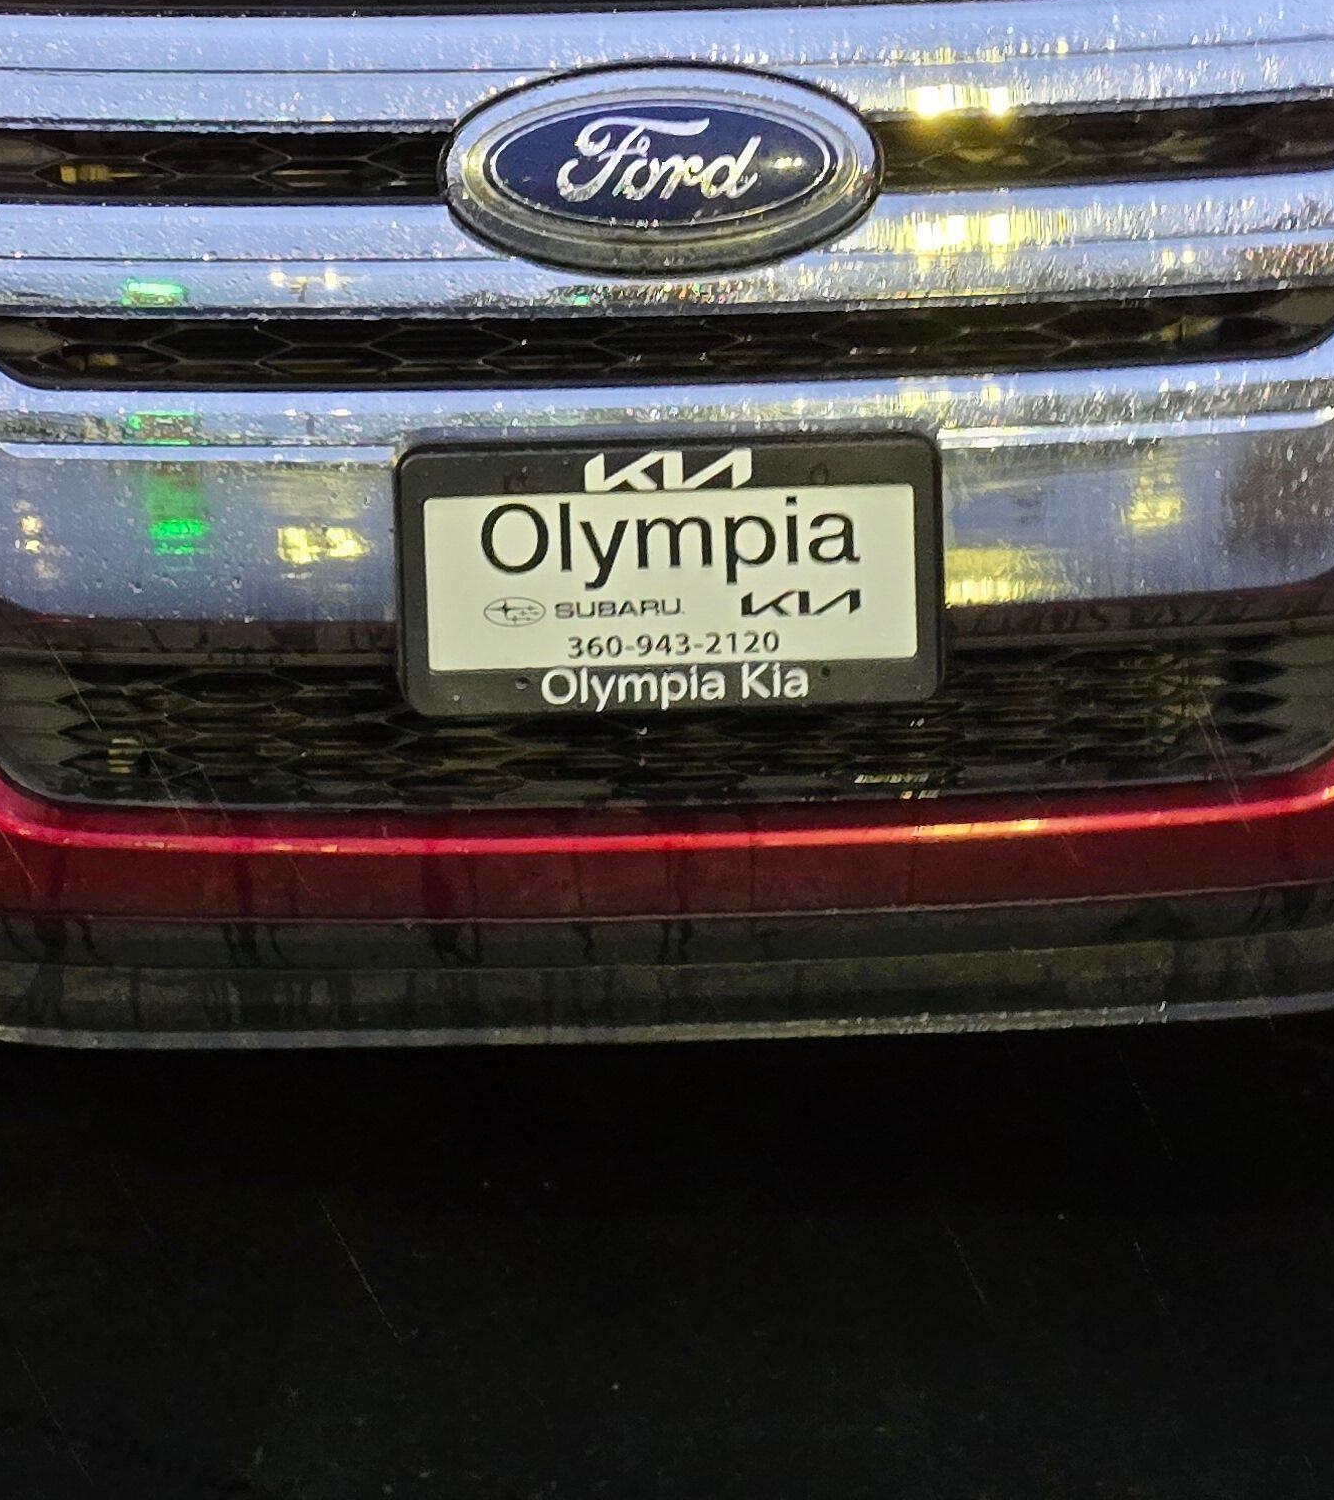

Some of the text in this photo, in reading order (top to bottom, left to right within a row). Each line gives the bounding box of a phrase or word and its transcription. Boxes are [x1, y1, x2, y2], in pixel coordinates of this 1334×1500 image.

[556, 116, 761, 201] Ford
[480, 496, 861, 590] Olympia
[554, 598, 683, 619] SUBARU
[567, 630, 780, 660] 360-943-2120
[541, 663, 810, 712] Olympia Kia
